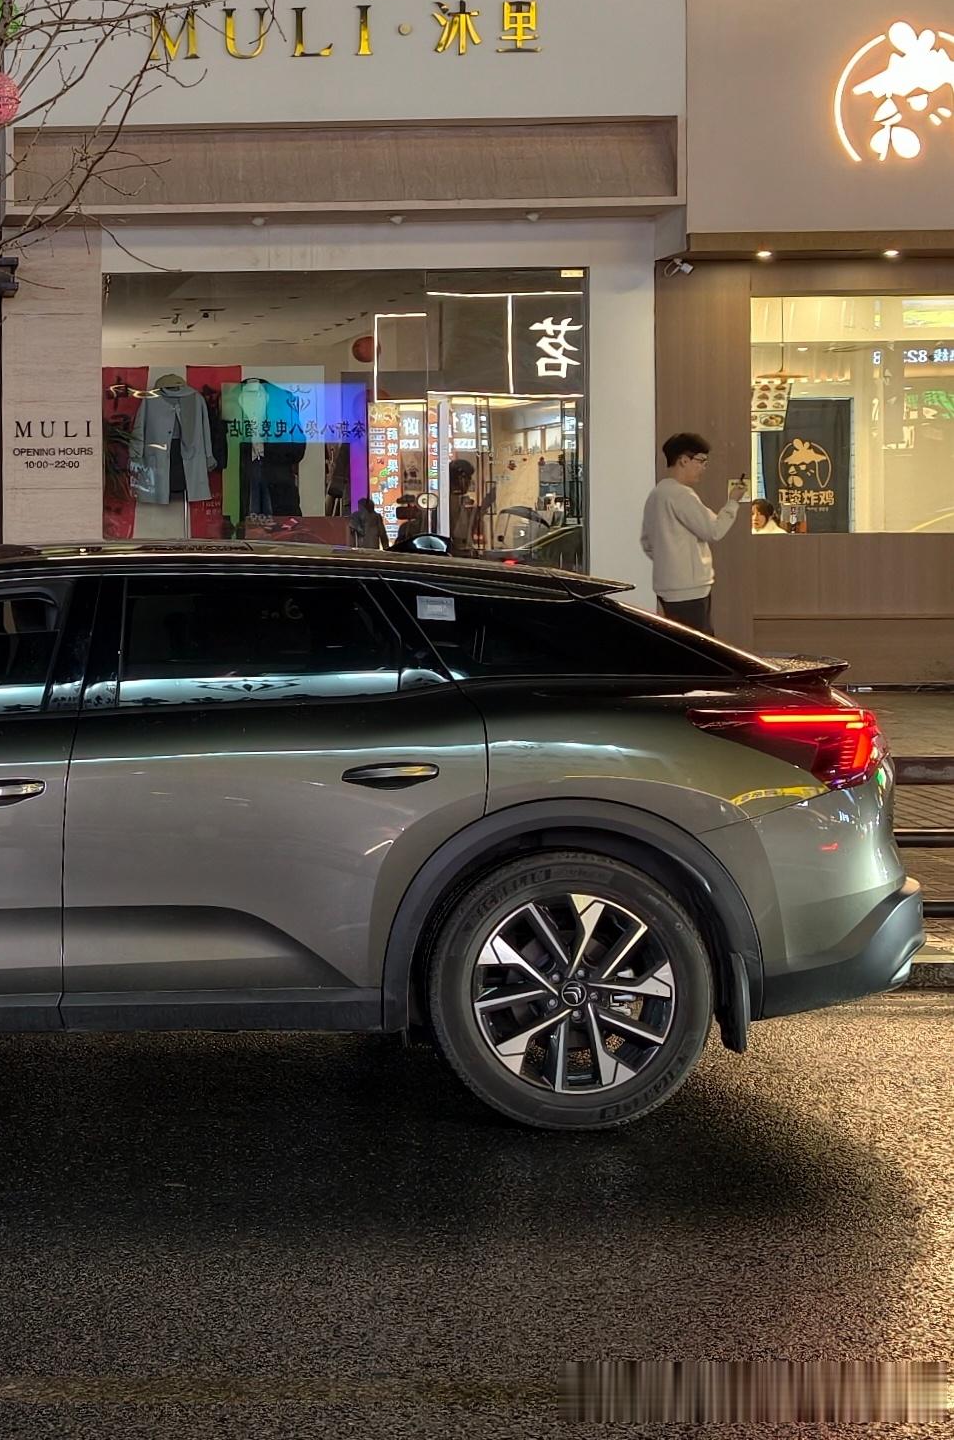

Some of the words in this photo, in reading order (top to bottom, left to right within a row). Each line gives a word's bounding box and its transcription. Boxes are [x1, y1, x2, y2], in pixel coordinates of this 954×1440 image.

[432, 0, 543, 56] 沐里
[14, 420, 91, 439] MULI
[13, 448, 56, 457] OPENING
[58, 447, 94, 456] HOURS
